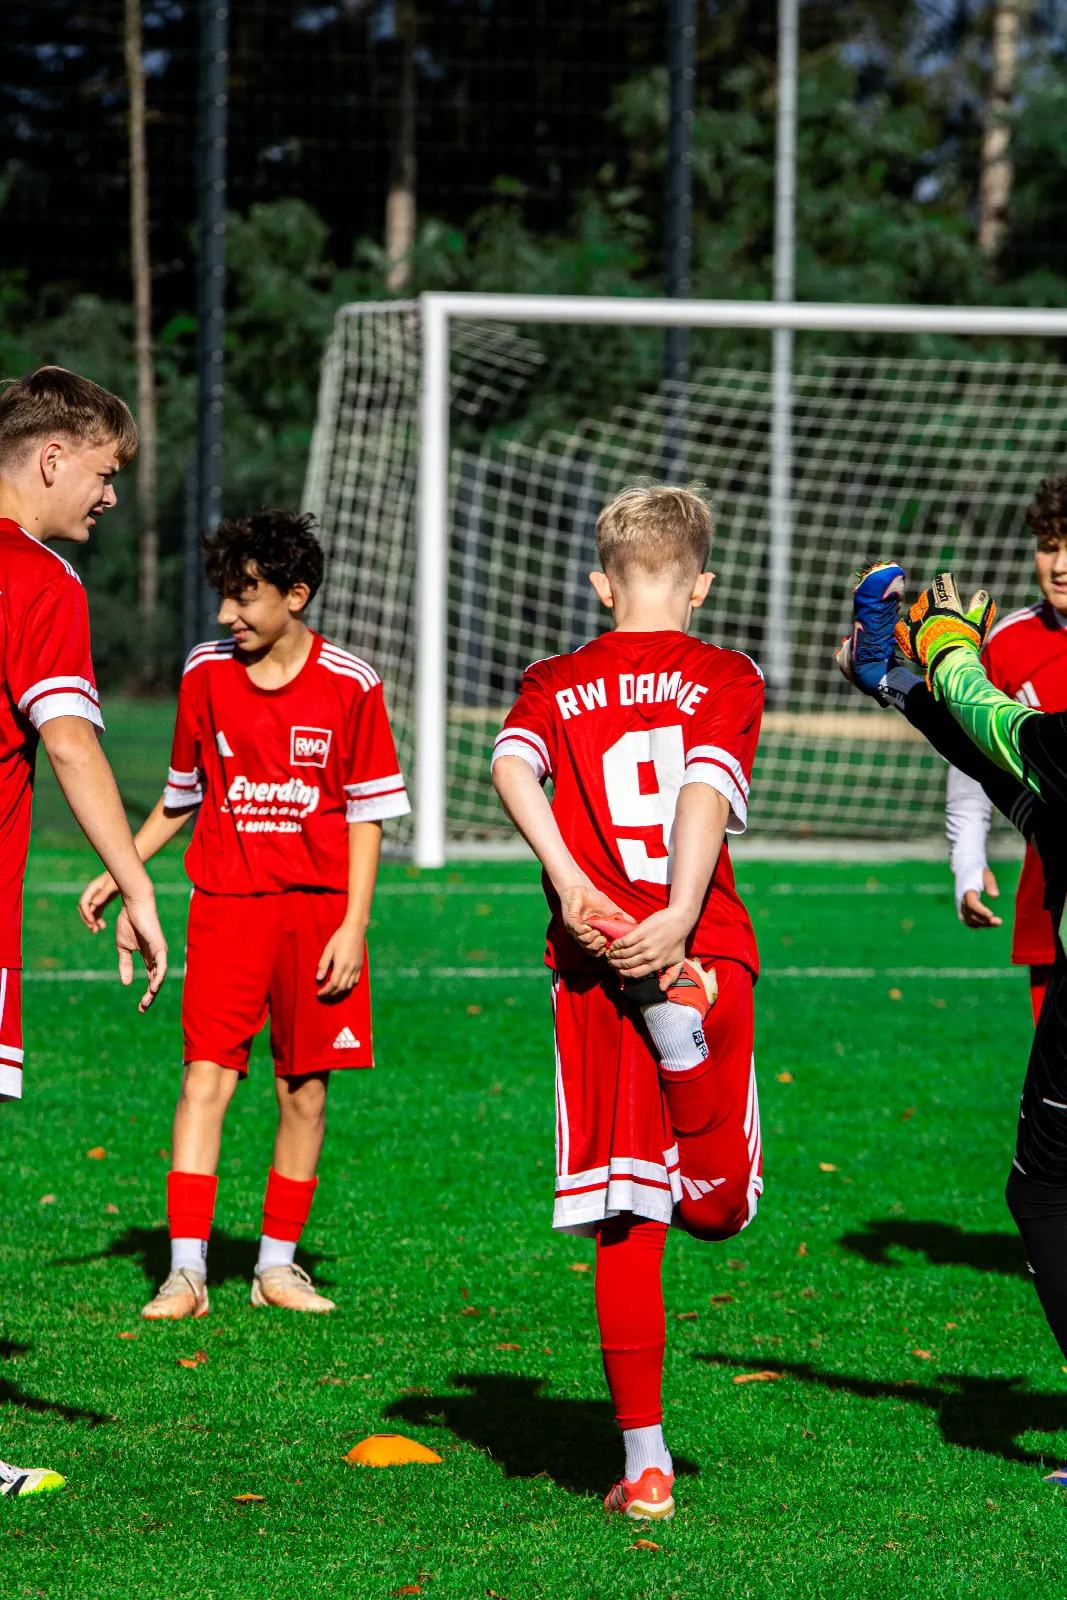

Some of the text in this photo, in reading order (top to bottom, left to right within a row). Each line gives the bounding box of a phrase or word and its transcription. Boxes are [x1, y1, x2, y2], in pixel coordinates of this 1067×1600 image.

[555, 677, 609, 720] RW
[295, 737, 329, 756] RWD
[227, 775, 320, 813] Everding
[602, 724, 687, 885] 9
